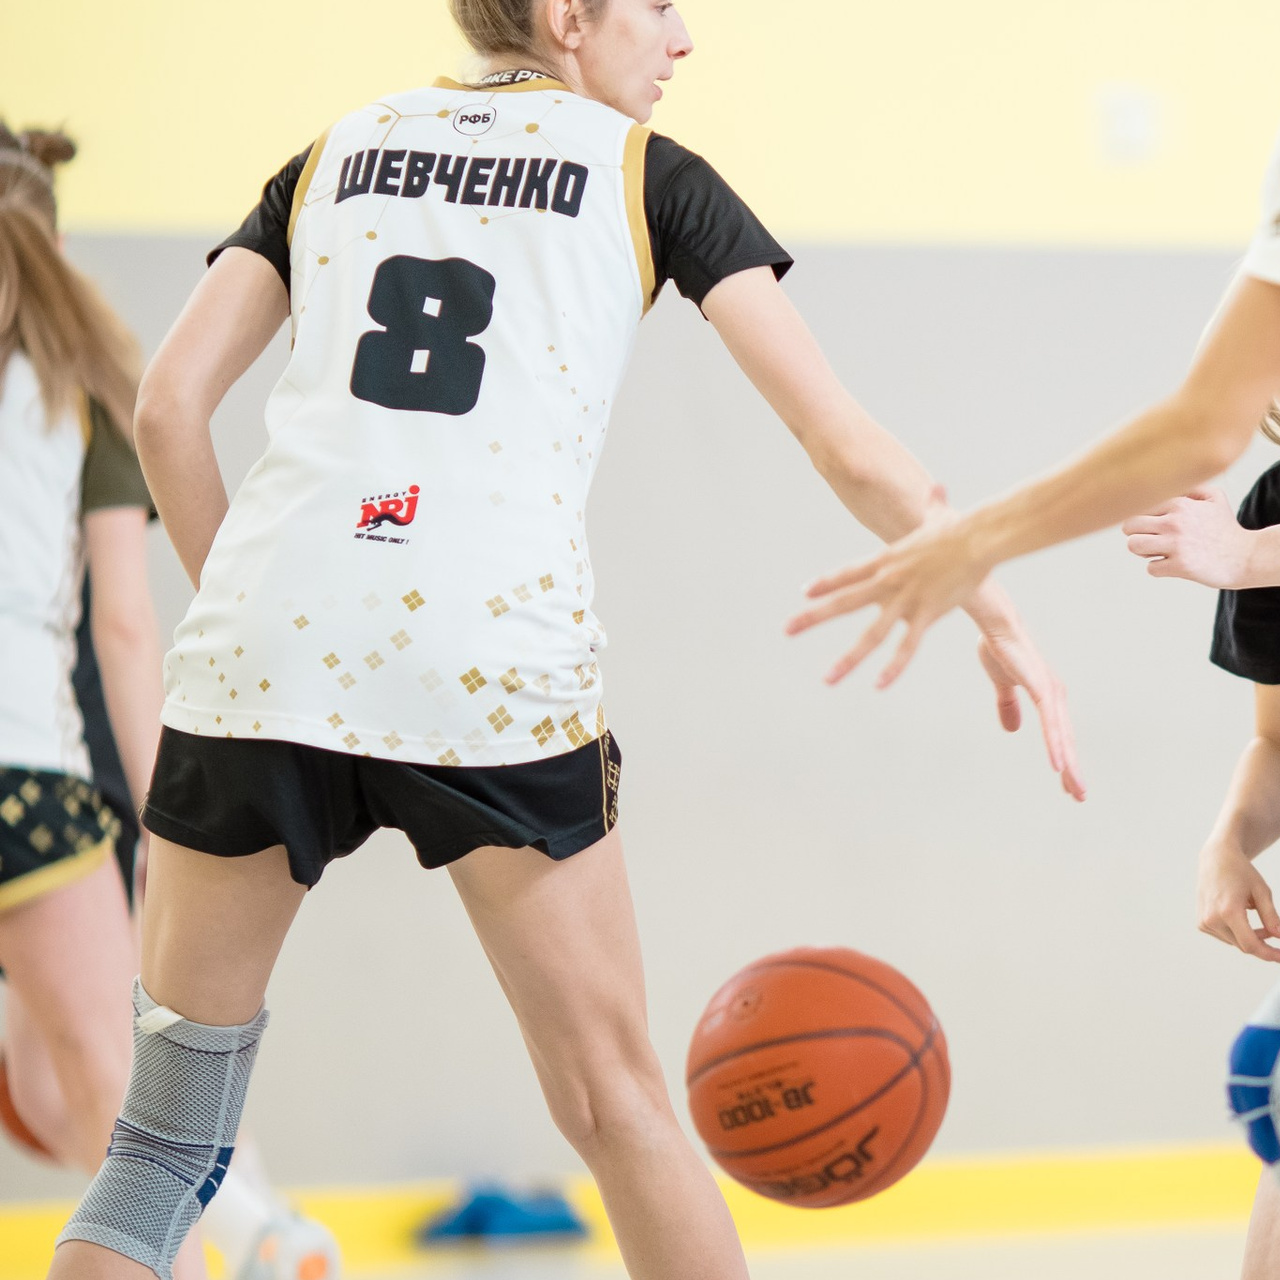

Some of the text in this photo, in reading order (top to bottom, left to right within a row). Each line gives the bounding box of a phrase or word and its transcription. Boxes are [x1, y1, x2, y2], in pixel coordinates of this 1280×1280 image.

[459, 113, 491, 125] РФБ
[334, 148, 589, 218] ШЕВЧЕНКО
[350, 254, 496, 416] 8
[356, 484, 420, 529] NRJ
